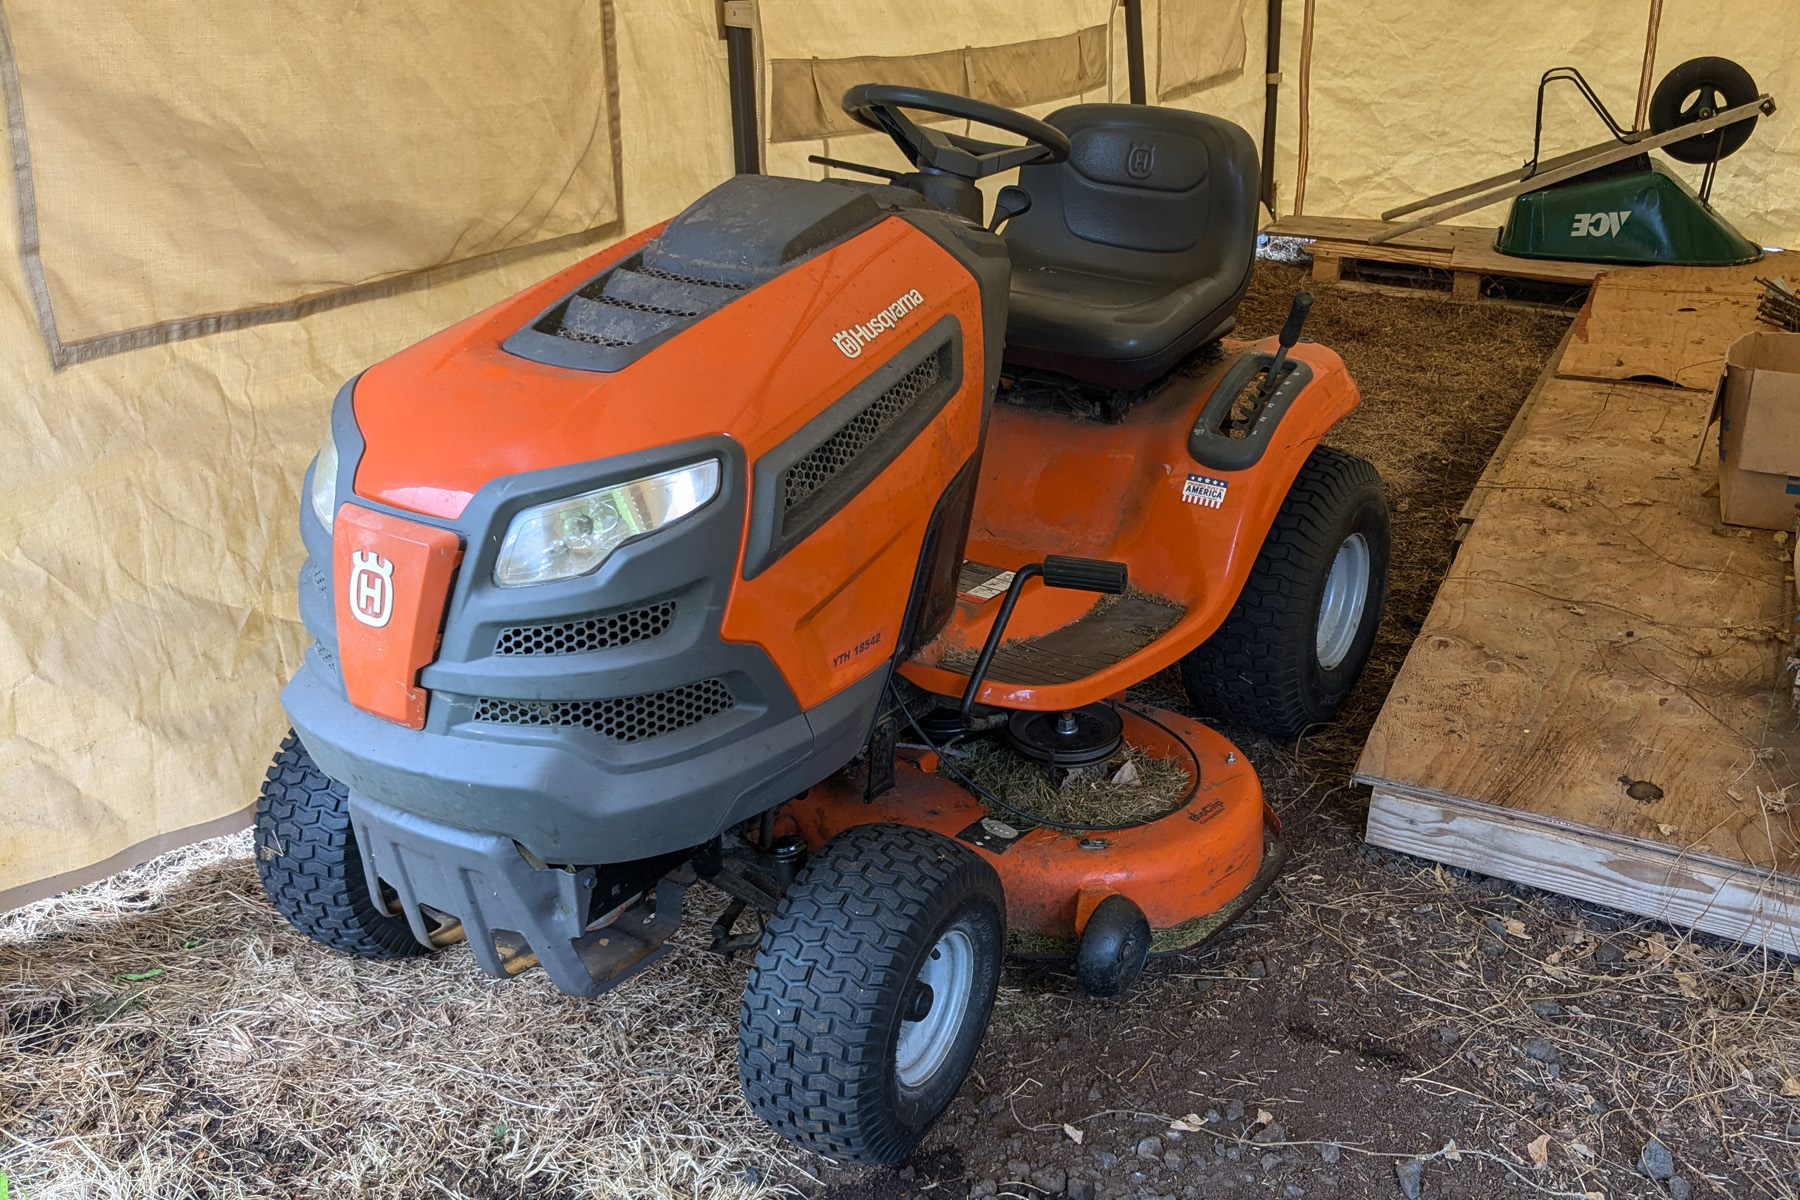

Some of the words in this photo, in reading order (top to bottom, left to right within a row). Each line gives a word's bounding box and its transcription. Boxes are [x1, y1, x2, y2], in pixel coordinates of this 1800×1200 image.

[1570, 210, 1632, 239] ACE
[848, 289, 925, 347] Husqvarna
[1185, 485, 1222, 499] AMERICA
[833, 650, 850, 667] YTH
[853, 632, 881, 656] 18542
[1188, 799, 1224, 823] BioClip
